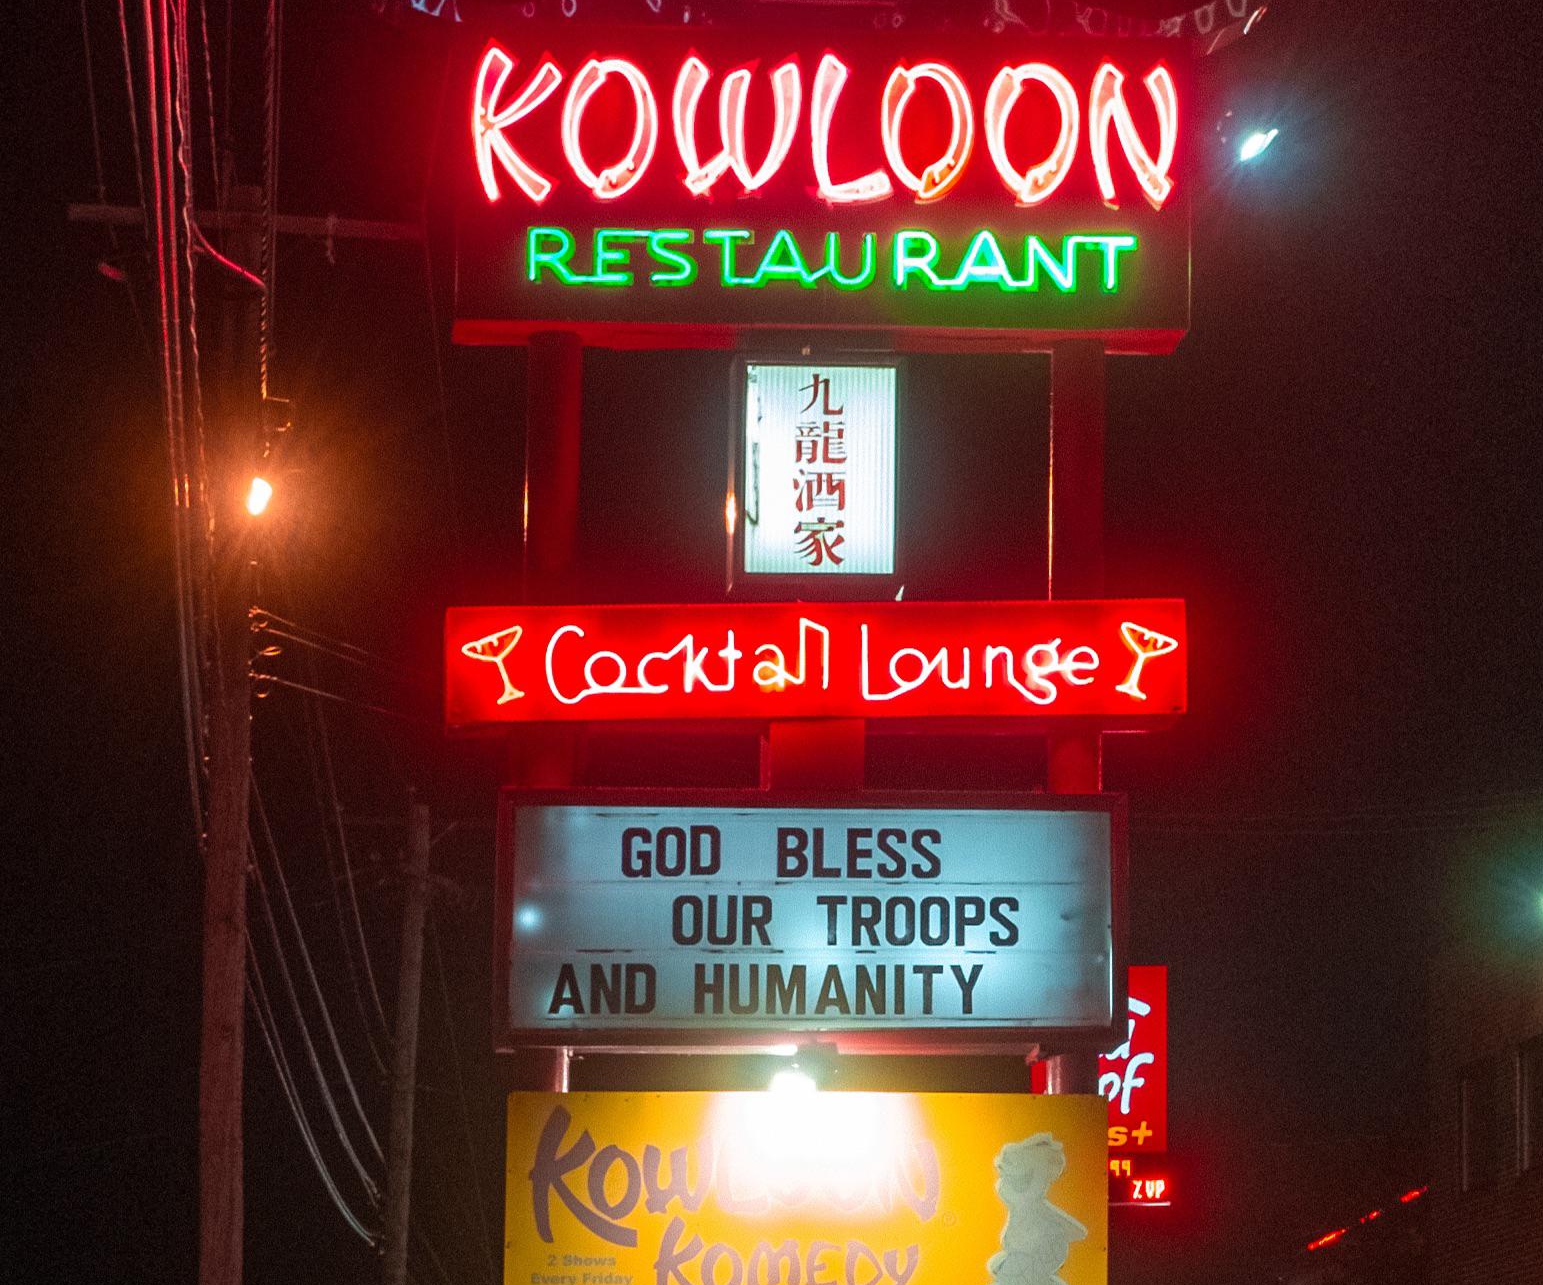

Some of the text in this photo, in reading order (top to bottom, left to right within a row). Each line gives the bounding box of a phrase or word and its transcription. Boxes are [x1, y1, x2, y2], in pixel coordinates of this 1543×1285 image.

[471, 42, 1179, 209] KOWLOON
[526, 227, 1138, 294] RESTAURANT
[792, 373, 848, 567] 九龍酒家
[545, 617, 1100, 706] Cocktail Lounge
[620, 825, 943, 879] GOD BLESS
[671, 895, 1020, 947] OUR TROOPS
[548, 963, 984, 1016] AND HUMANITY
[548, 1255, 616, 1266] 2 Shows
